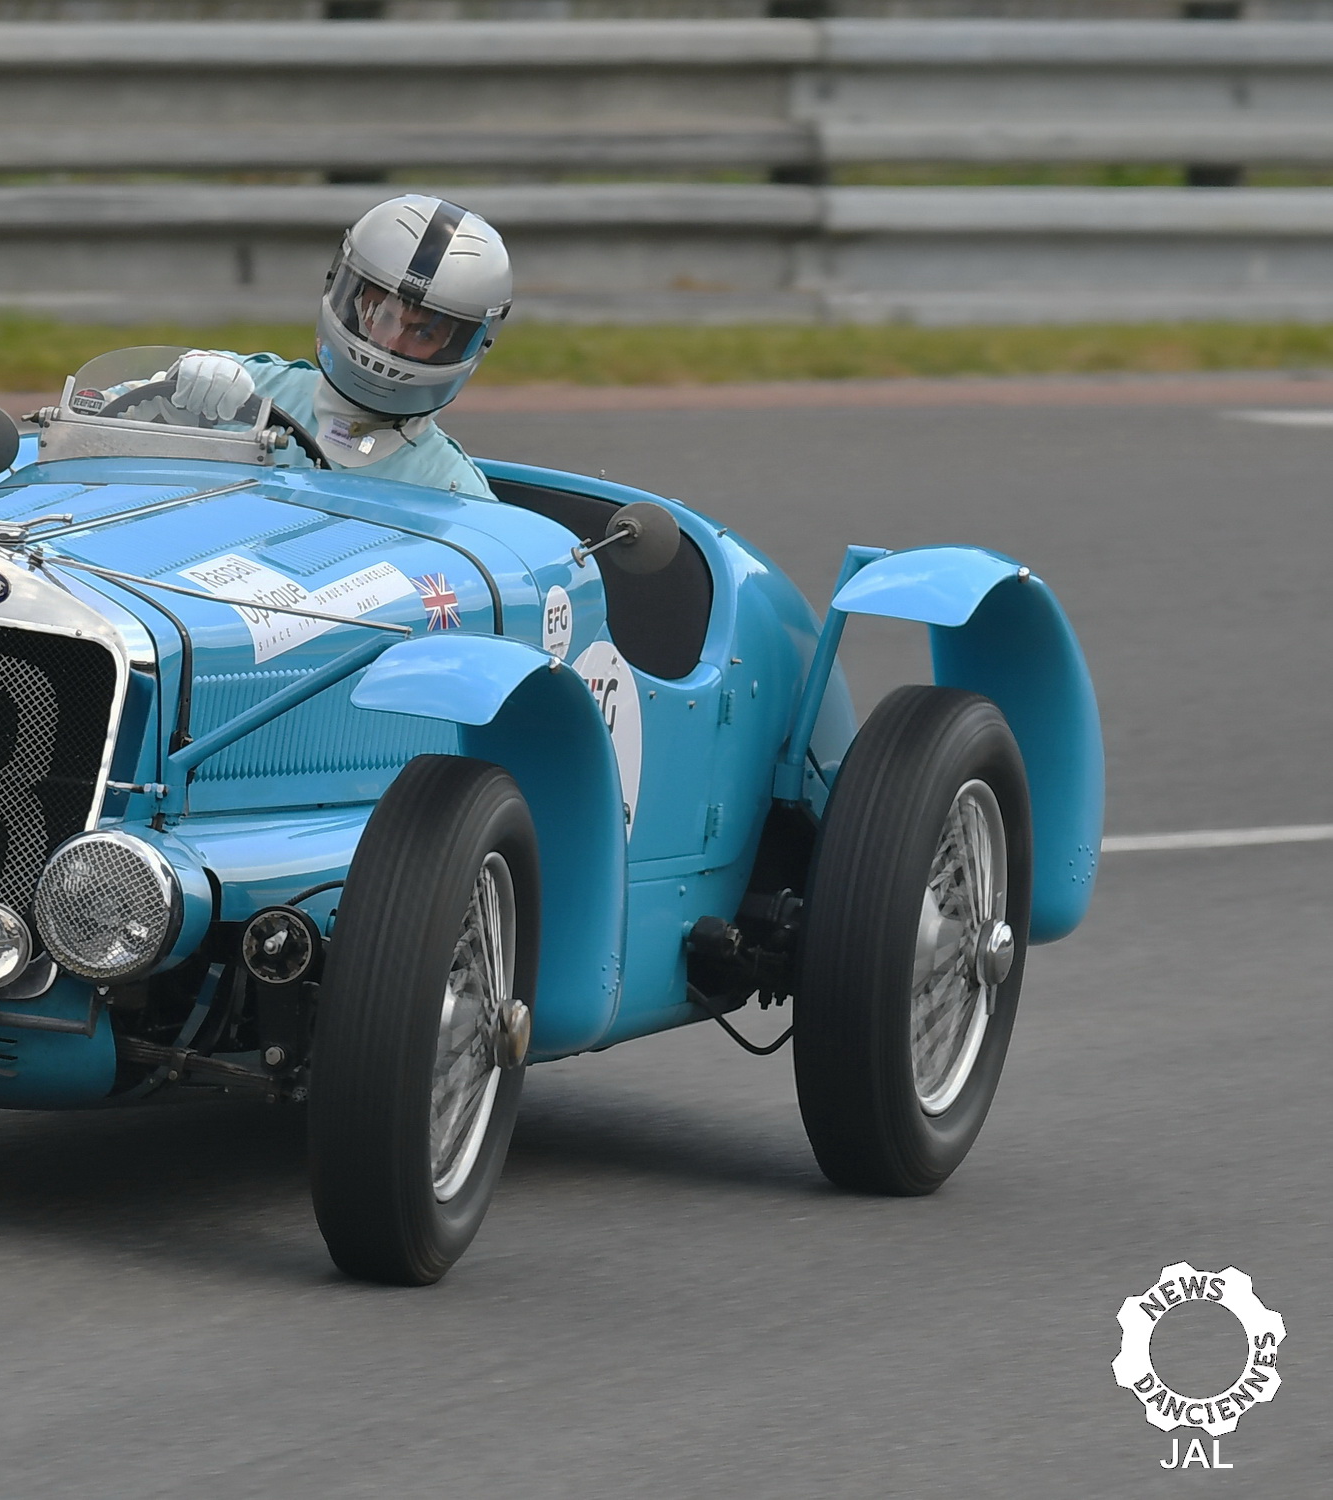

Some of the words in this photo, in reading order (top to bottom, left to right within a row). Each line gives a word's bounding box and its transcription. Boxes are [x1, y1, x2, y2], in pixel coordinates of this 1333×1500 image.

[189, 557, 261, 589] Raspail
[325, 587, 343, 600] RUE
[340, 582, 354, 593] DE
[351, 564, 397, 588] COURCELLES
[356, 595, 380, 612] PARIS
[547, 604, 568, 635] EFG
[258, 628, 291, 652] SINCE
